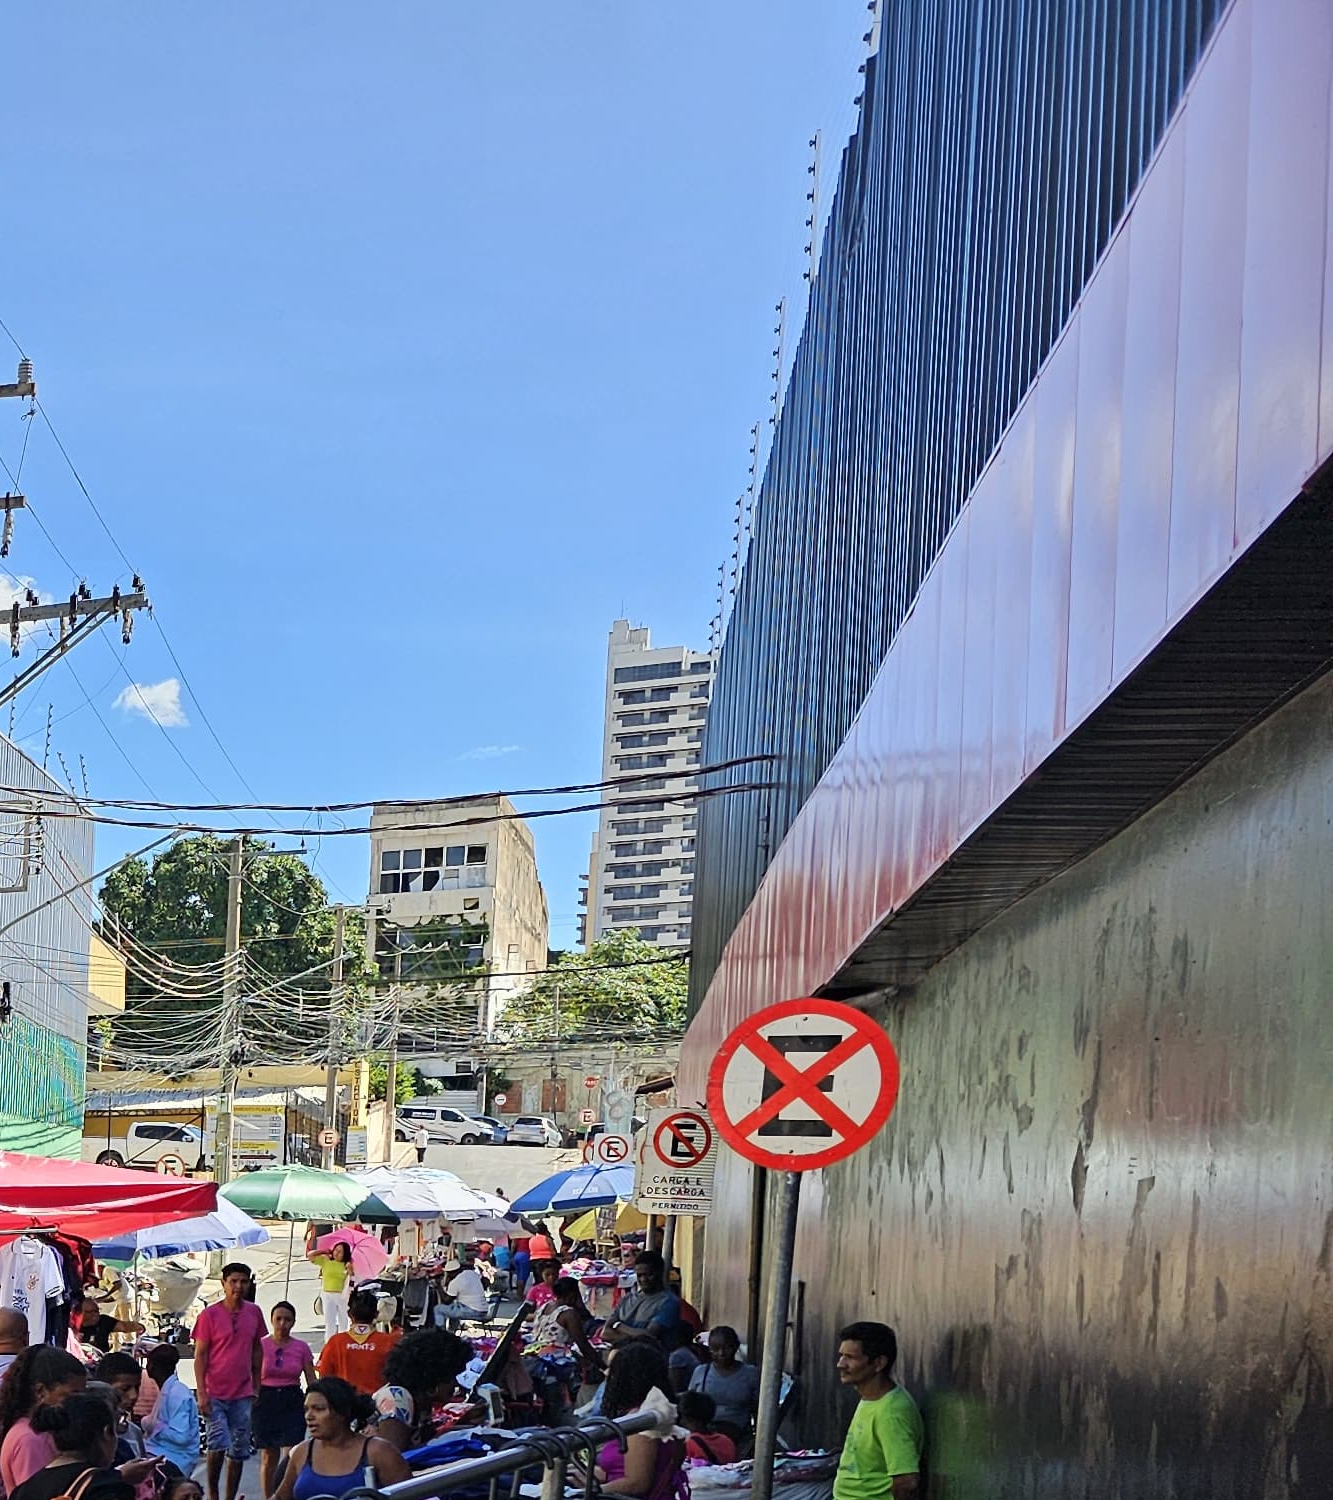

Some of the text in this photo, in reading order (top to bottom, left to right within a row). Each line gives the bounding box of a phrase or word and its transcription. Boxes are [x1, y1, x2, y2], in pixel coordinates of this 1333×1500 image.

[759, 1035, 843, 1137] E
[671, 1123, 697, 1158] E
[646, 1186, 706, 1197] DESCARGA
[652, 1175, 702, 1186] CARGA E
